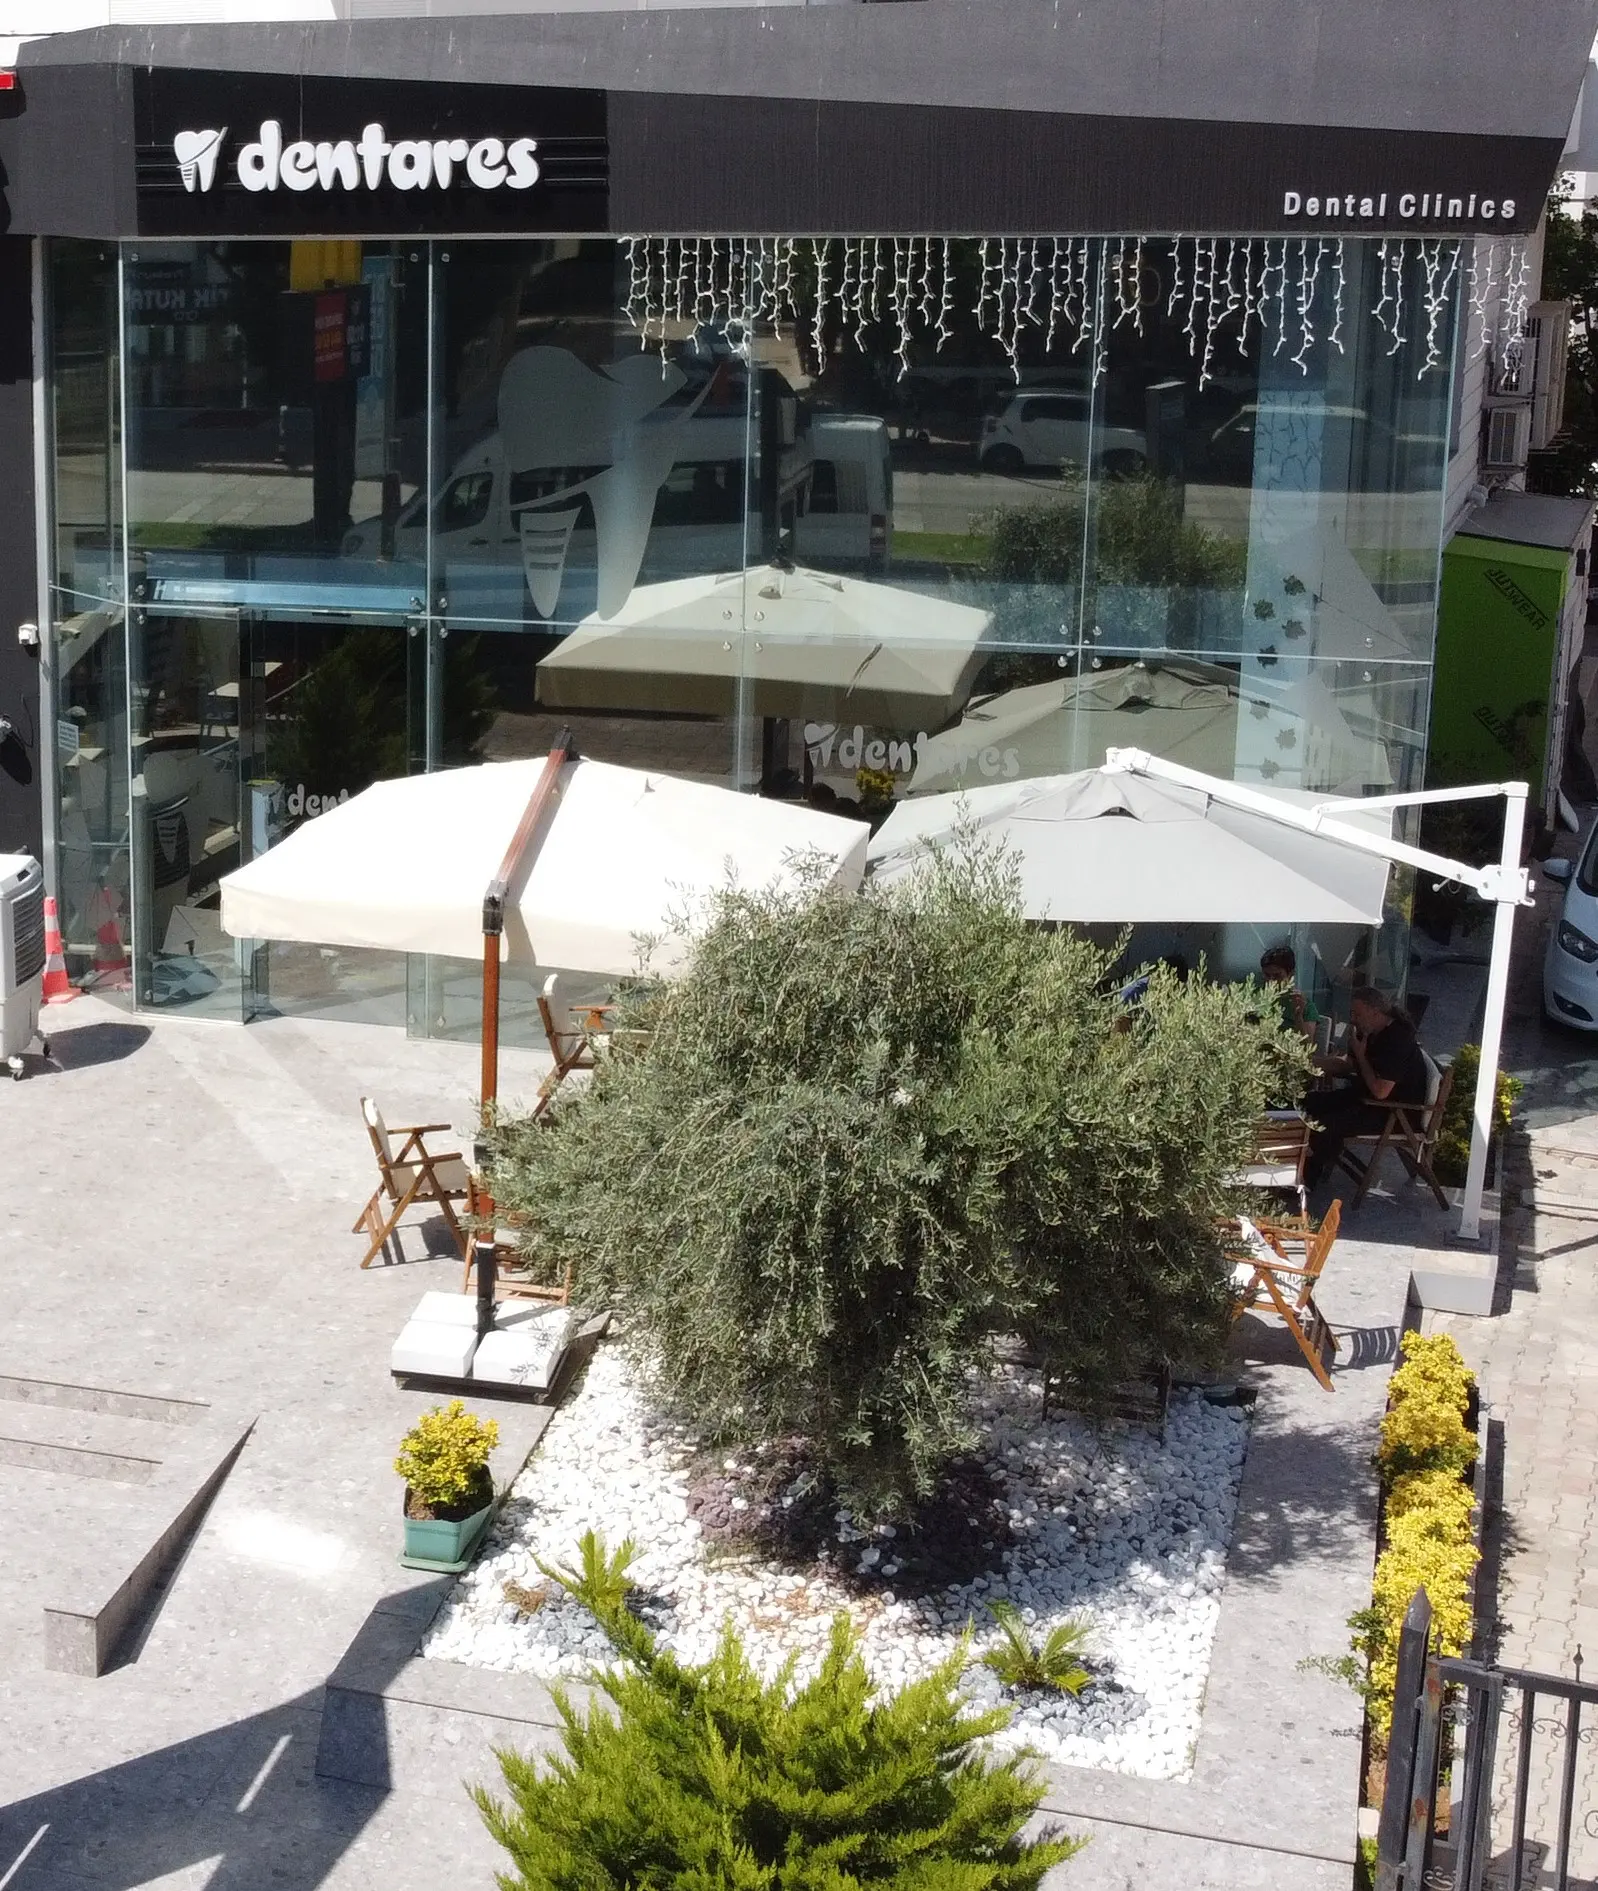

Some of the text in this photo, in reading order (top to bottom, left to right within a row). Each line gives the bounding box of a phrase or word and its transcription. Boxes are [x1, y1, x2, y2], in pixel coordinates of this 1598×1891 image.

[236, 119, 541, 192] dentares
[1283, 191, 1517, 219] Dental Clinics
[837, 724, 1021, 778] dentres
